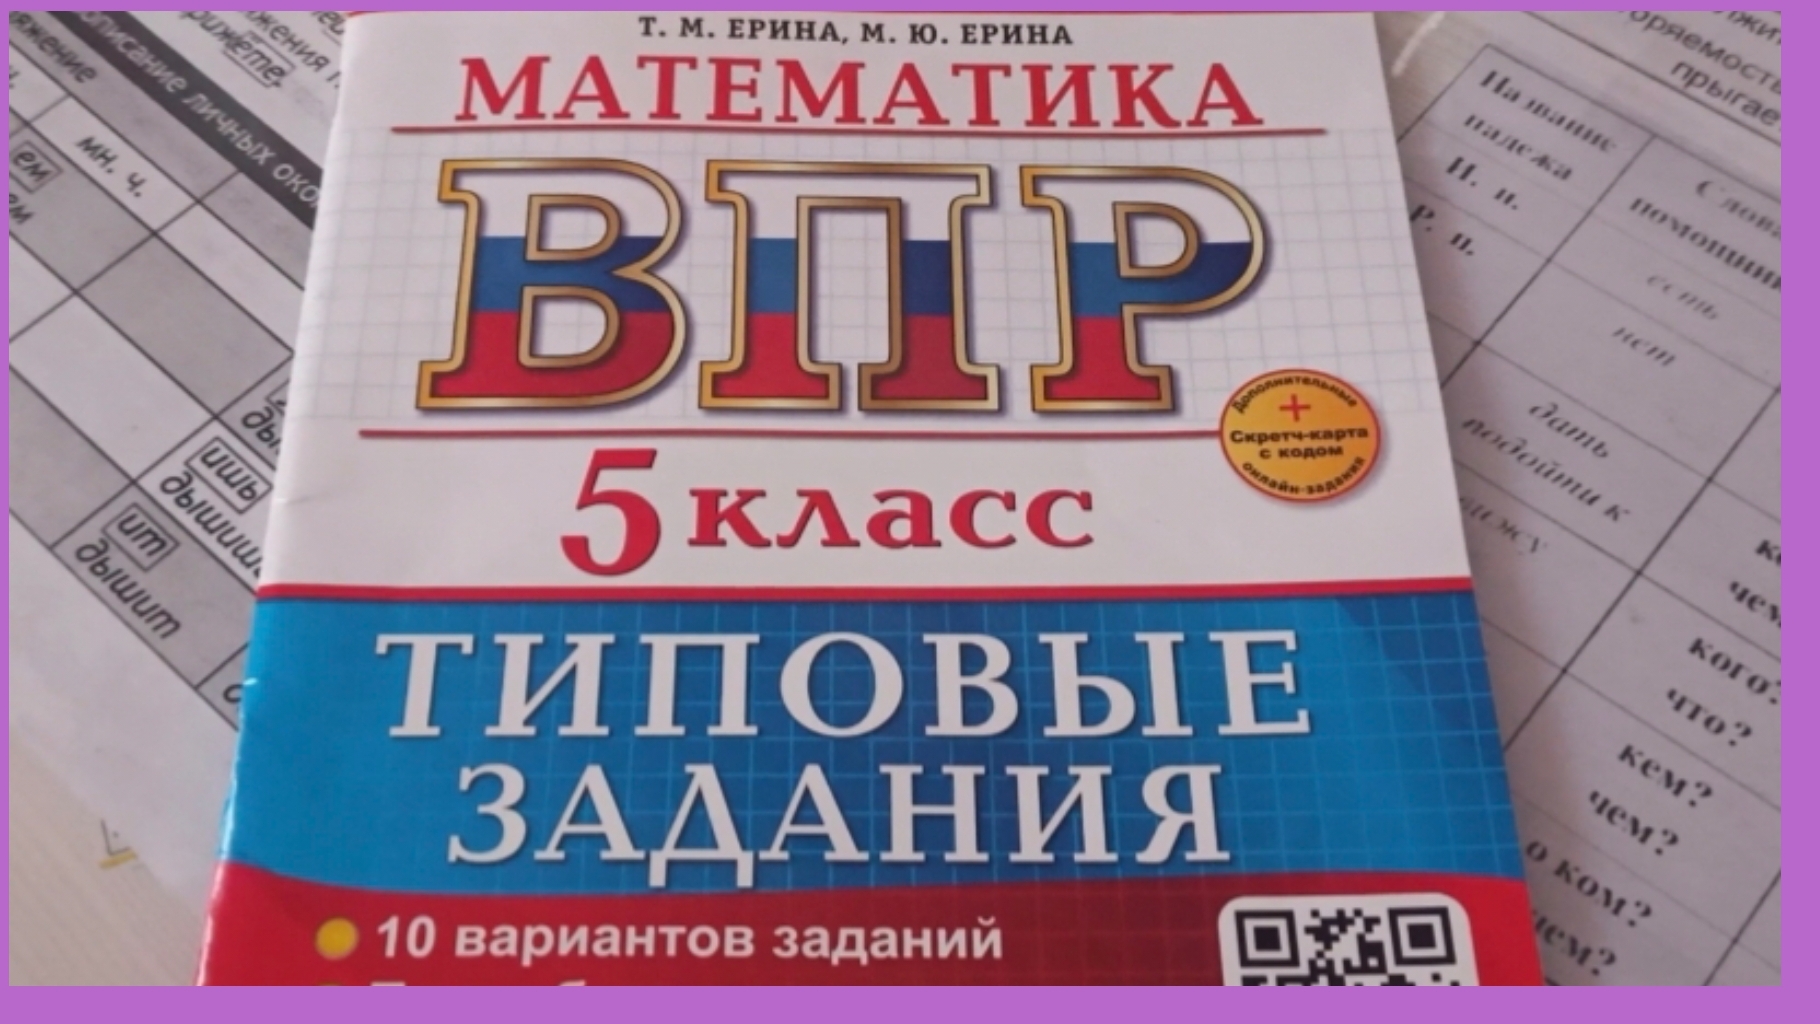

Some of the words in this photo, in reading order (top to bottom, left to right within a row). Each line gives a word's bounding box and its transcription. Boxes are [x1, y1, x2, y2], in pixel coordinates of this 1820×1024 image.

[639, 16, 667, 38] Т.
[680, 16, 715, 38] М.
[728, 18, 848, 45] ЕРИНА,
[861, 22, 895, 44] М.
[909, 23, 948, 45] Ю.
[961, 23, 1074, 46] ЕРИНА
[455, 54, 1265, 128] МАТЕМАТИКА
[1479, 69, 1618, 154] Название
[1670, 60, 1782, 127] прыгае
[183, 92, 276, 166] личных
[1463, 113, 1574, 182] падежа
[75, 135, 117, 175] мн.
[126, 170, 143, 199] ч.
[415, 157, 1269, 413] ВПР
[1231, 376, 1359, 415] Дополнительные
[1230, 427, 1369, 446] Скретч-карта
[1259, 448, 1272, 459] с
[1278, 445, 1344, 460] кодом
[1461, 416, 1603, 508] подойти
[1528, 400, 1610, 460] дать
[1242, 456, 1366, 496] онлайн-задания
[560, 446, 660, 577] 5
[688, 486, 1095, 549] класс
[75, 538, 181, 640] дышит
[374, 629, 1312, 740] ТИПОВЫЕ
[1666, 687, 1753, 748] что?
[1617, 744, 1714, 809] кем?
[445, 762, 1232, 888] ЗАДАНИЯ
[1587, 789, 1680, 857] чем?
[1553, 859, 1653, 929] ком?
[376, 915, 436, 959] 10
[455, 922, 755, 967] вариантов
[772, 916, 1004, 968] заданий
